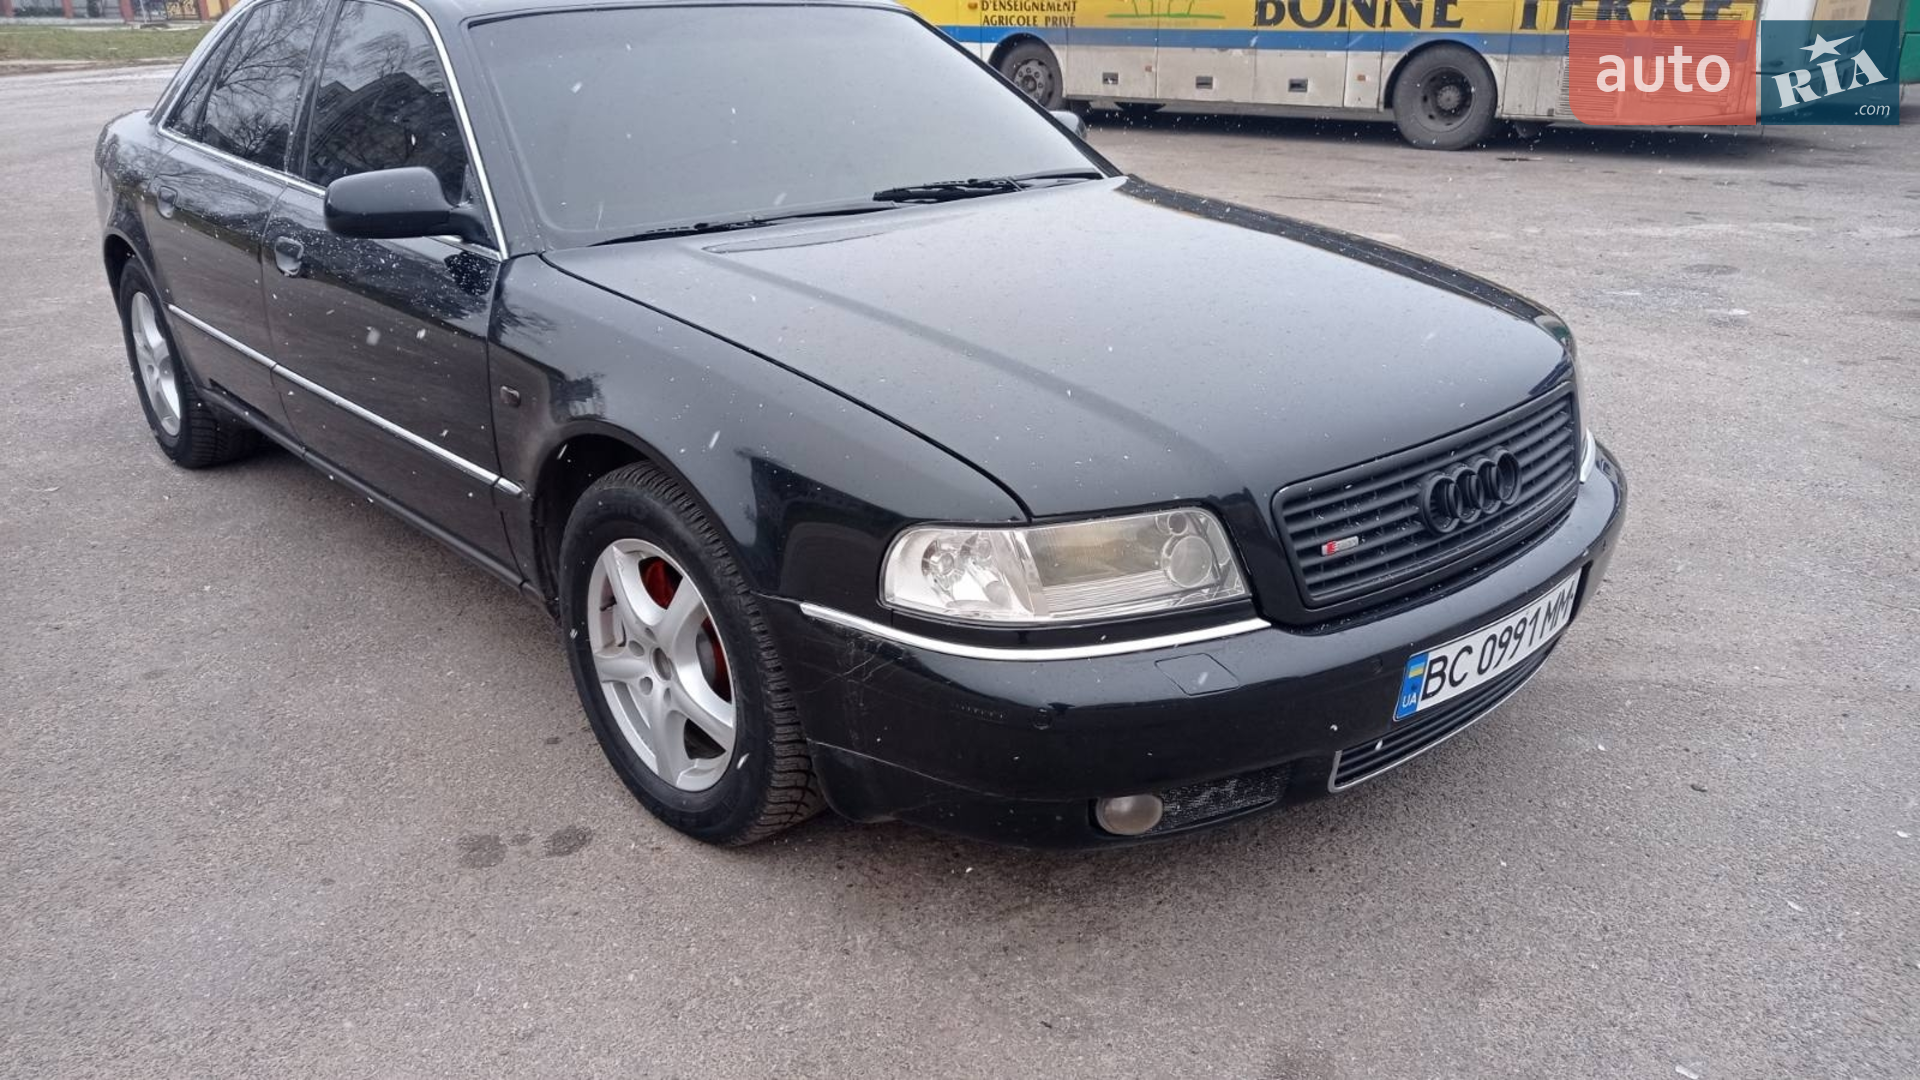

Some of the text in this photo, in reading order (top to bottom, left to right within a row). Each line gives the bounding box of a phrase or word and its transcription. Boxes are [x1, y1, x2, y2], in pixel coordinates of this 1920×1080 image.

[981, 0, 1077, 12] D'ENSEIGNEMENT
[983, 15, 1038, 27] AGRICOLE
[1420, 580, 1575, 702] BC 0991 MM
[1402, 694, 1417, 708] UA
